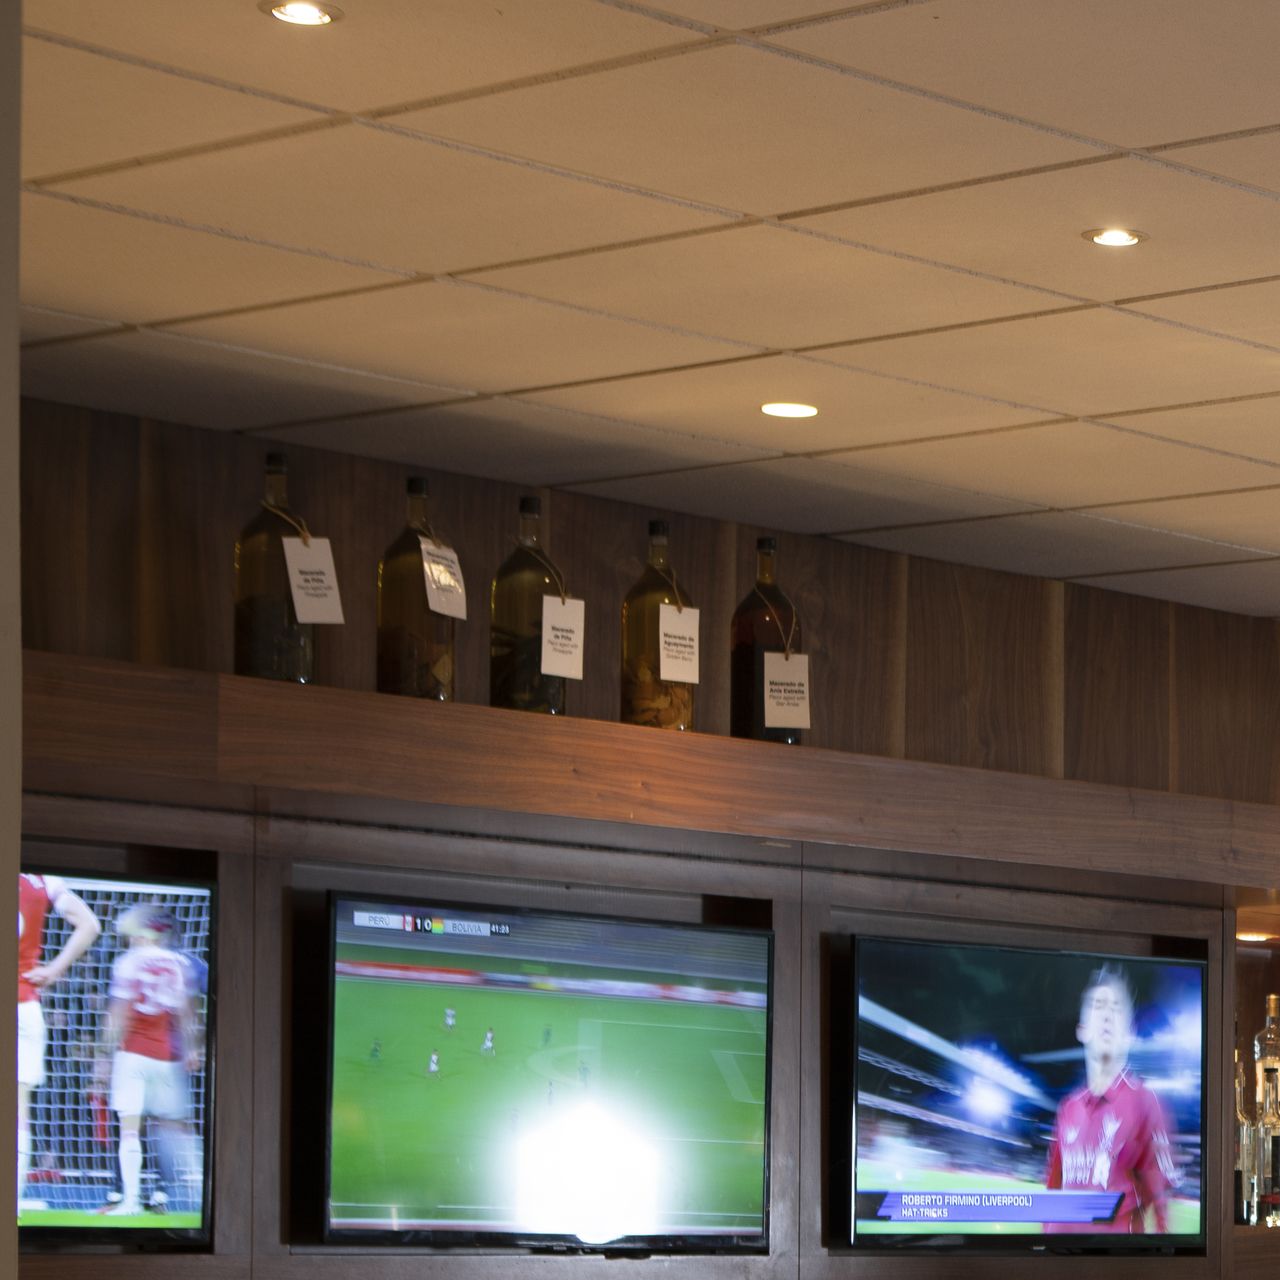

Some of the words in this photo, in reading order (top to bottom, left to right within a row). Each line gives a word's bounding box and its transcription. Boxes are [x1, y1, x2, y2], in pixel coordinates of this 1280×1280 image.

[424, 919, 432, 931] 0
[452, 923, 482, 935] BOLIVIA
[901, 1194, 943, 1206] ROBERTO
[944, 1195, 981, 1207] FIRMINO
[982, 1195, 1033, 1207] (LIVERPOOL)
